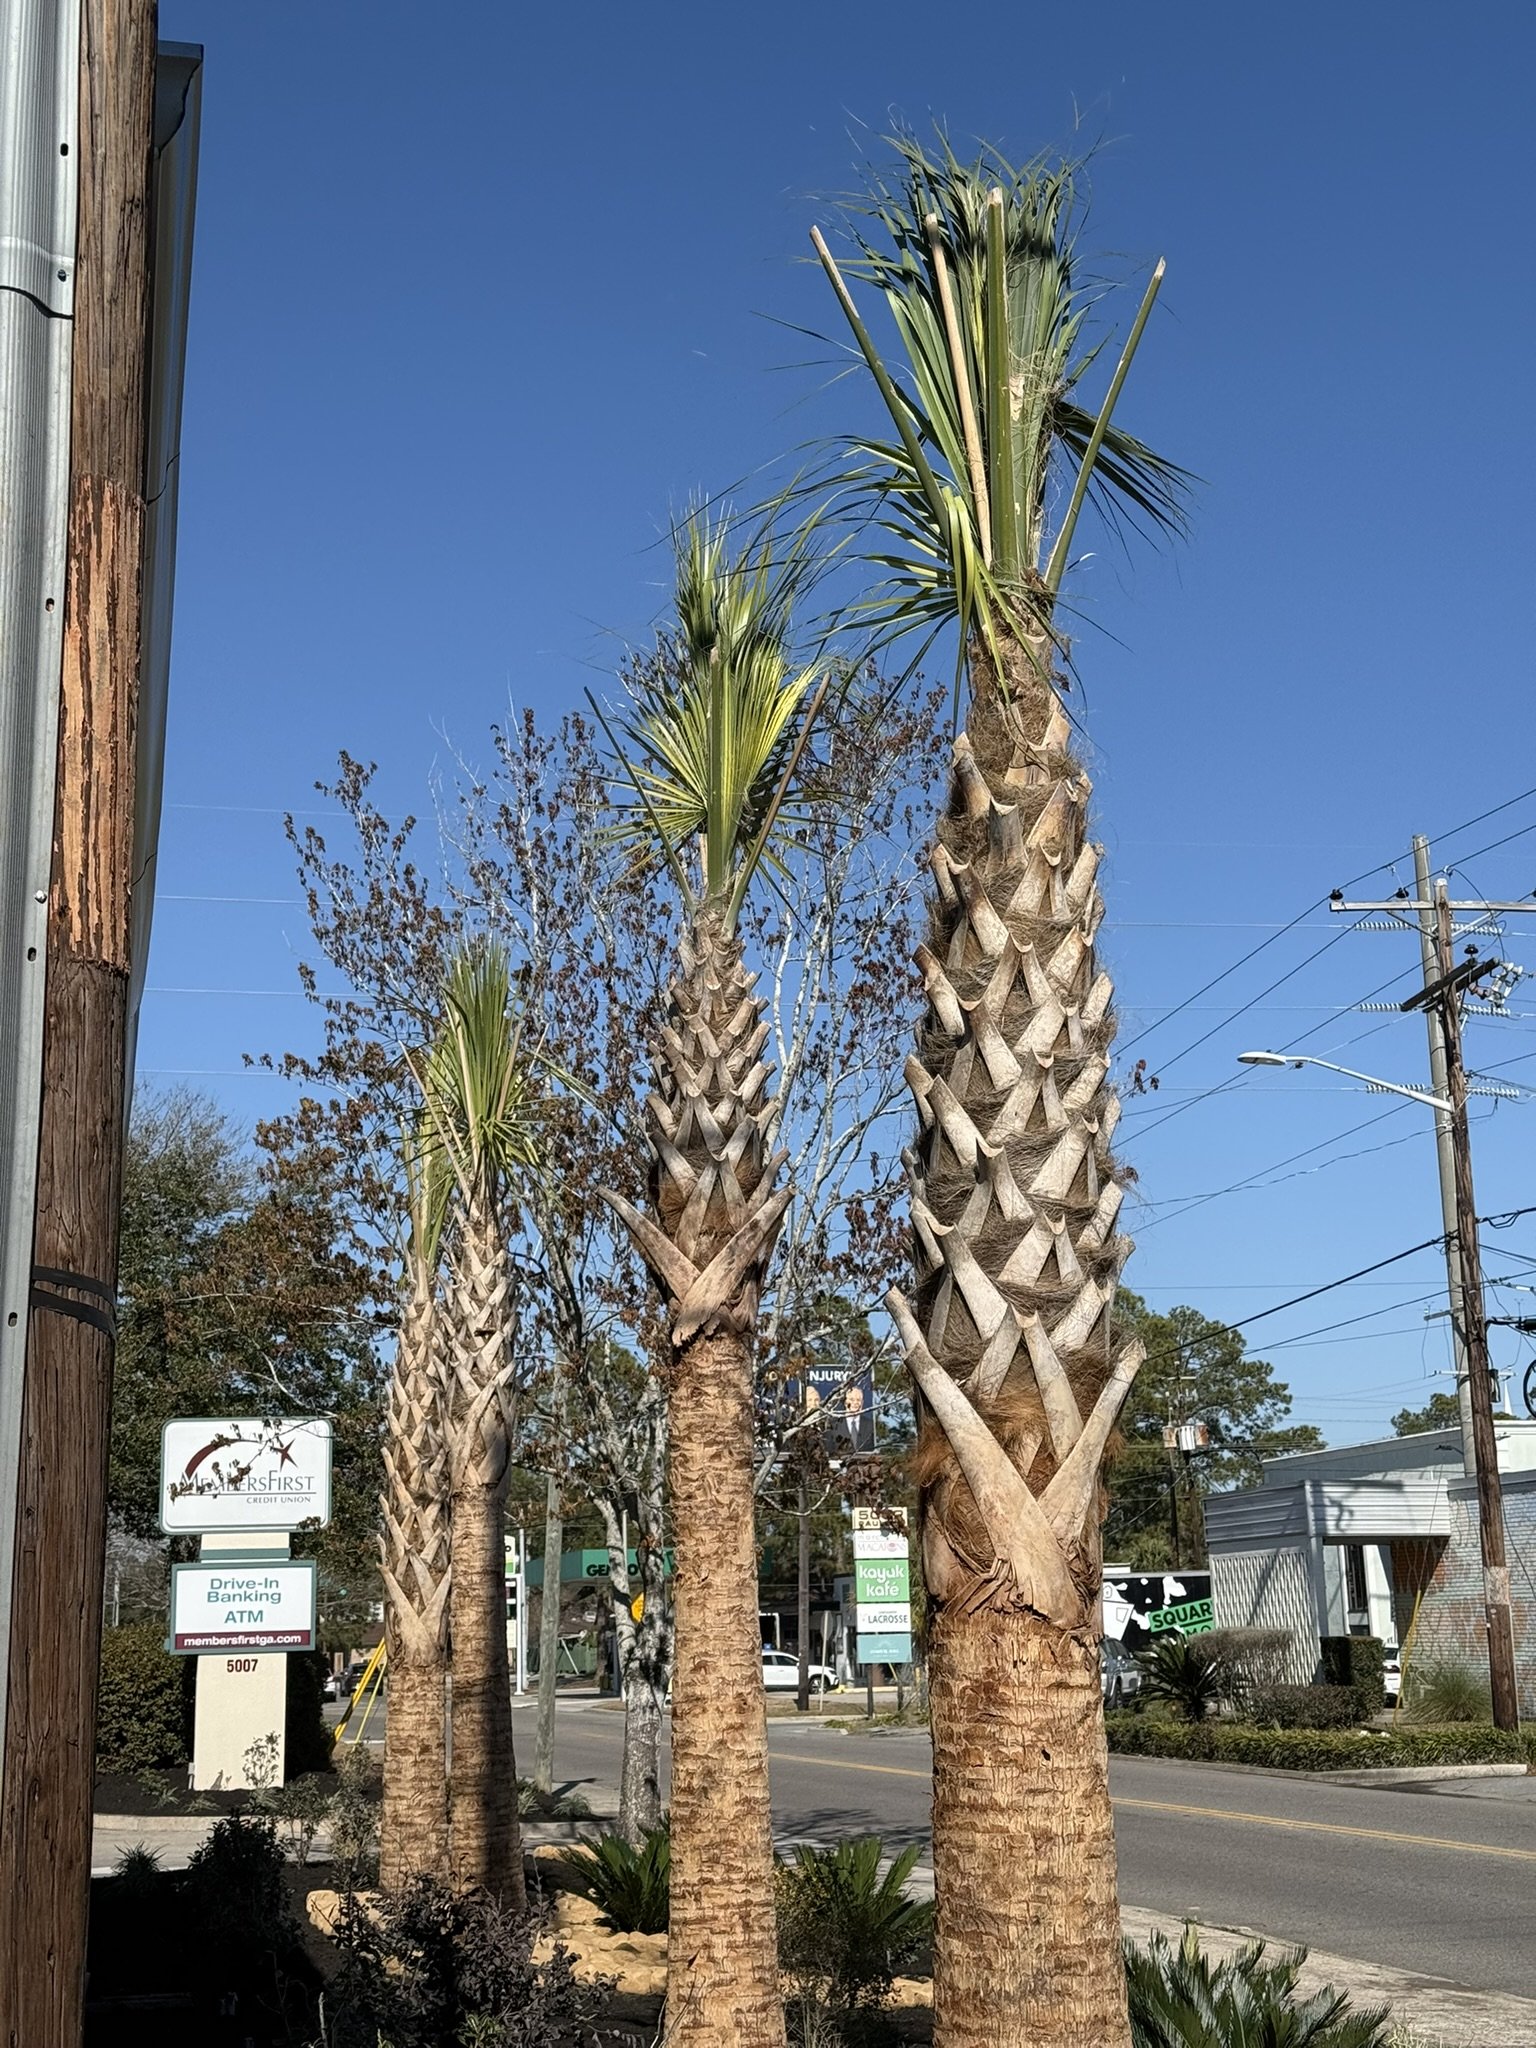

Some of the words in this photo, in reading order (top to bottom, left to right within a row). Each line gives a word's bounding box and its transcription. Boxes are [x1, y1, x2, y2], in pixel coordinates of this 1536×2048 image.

[246, 1496, 278, 1504] CREDIT
[210, 1577, 279, 1590] Drive-In
[866, 1580, 899, 1597] kafé
[207, 1590, 282, 1604] Banking
[224, 1610, 264, 1624] ATM
[867, 1614, 908, 1624] LACROSSE
[1152, 1601, 1213, 1629] SQUAR
[183, 1634, 302, 1647] membersfirstga.com
[226, 1658, 259, 1673] 5007
